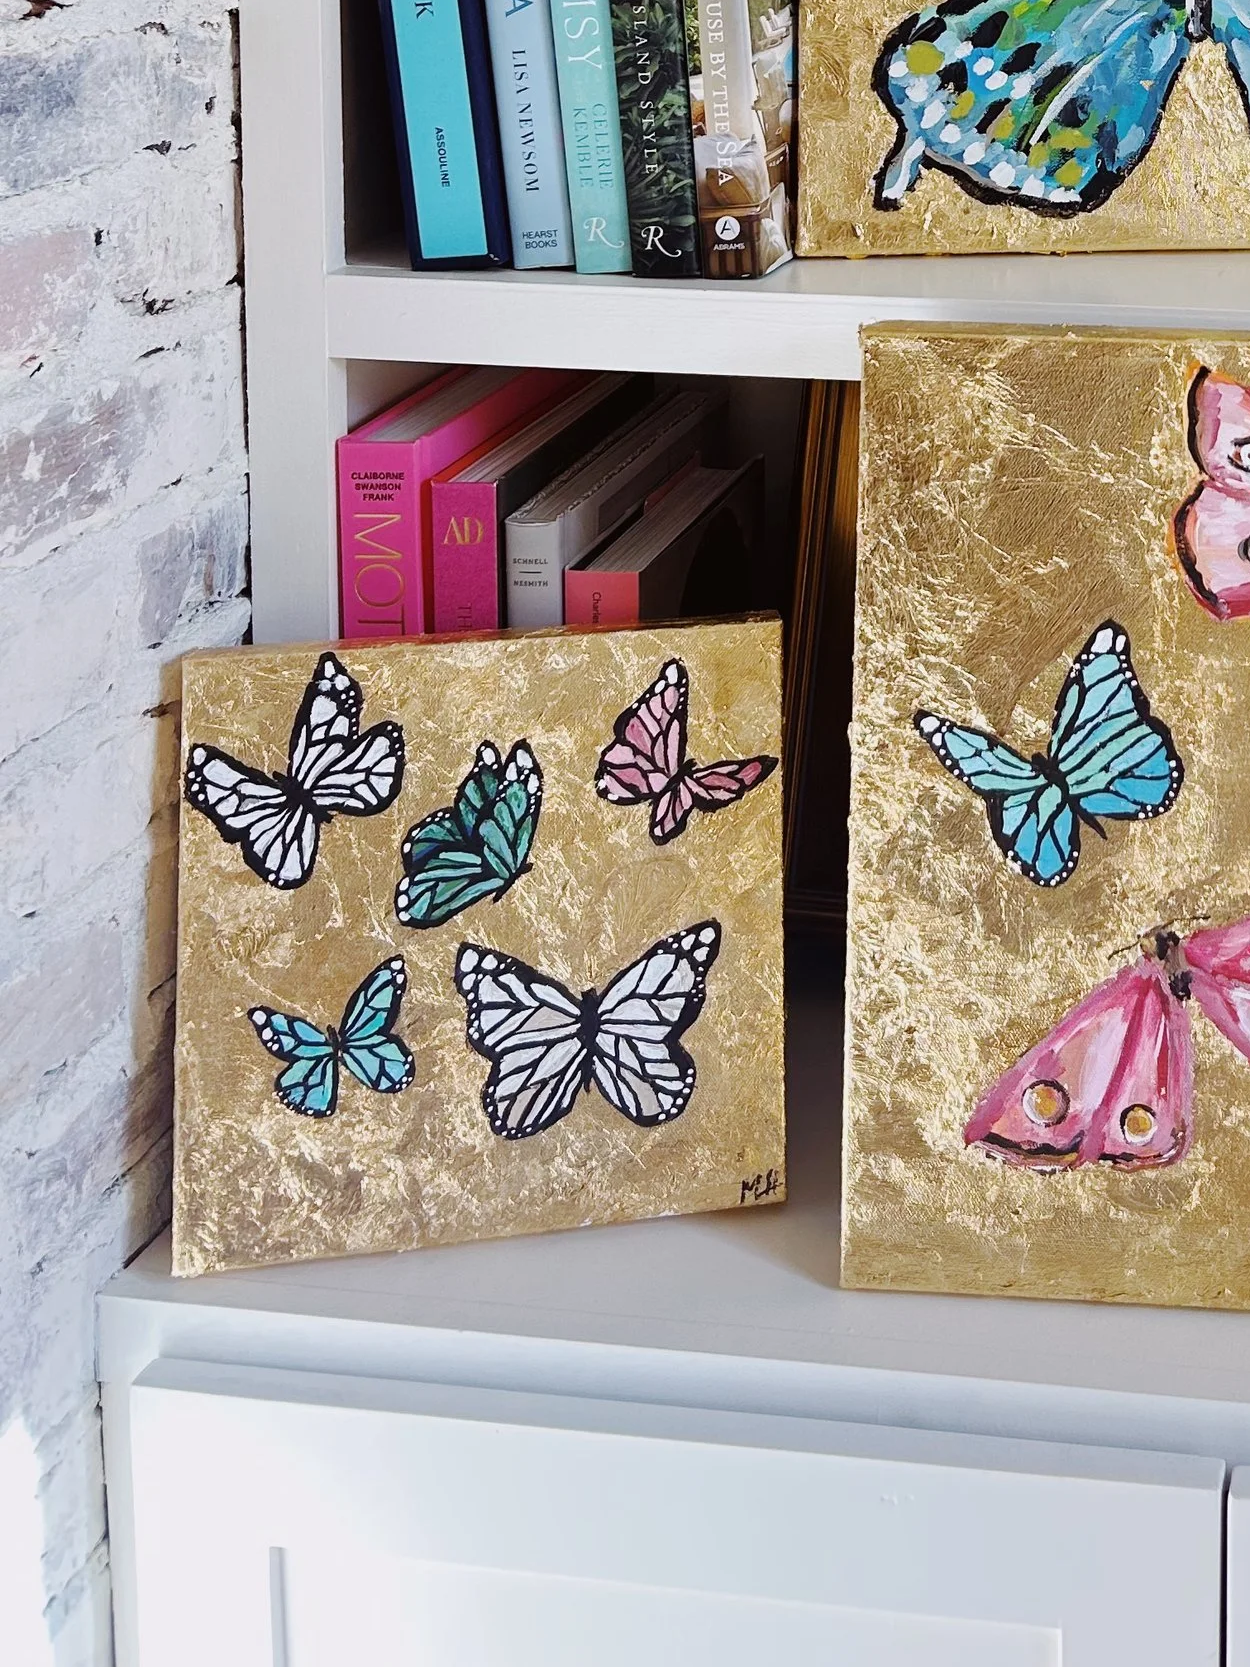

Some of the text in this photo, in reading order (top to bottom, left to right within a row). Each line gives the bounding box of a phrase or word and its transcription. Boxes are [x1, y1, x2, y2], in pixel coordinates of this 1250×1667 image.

[709, 51, 727, 80] BY
[511, 49, 541, 192] LISA NEWSOM
[712, 86, 730, 134] THE
[573, 106, 595, 189] KEMBLE
[592, 102, 614, 190] CELERIE
[639, 100, 659, 175] STYLE
[434, 126, 451, 188] ASSOULINE
[715, 140, 739, 187] SEA
[522, 229, 559, 239] HEARST
[525, 238, 558, 250] BOOKS
[713, 241, 746, 251] ABRAMS
[351, 472, 405, 481] CLAIBORNE
[354, 483, 402, 491] SWANSON
[362, 493, 395, 502] FRANK
[443, 516, 485, 546] AD
